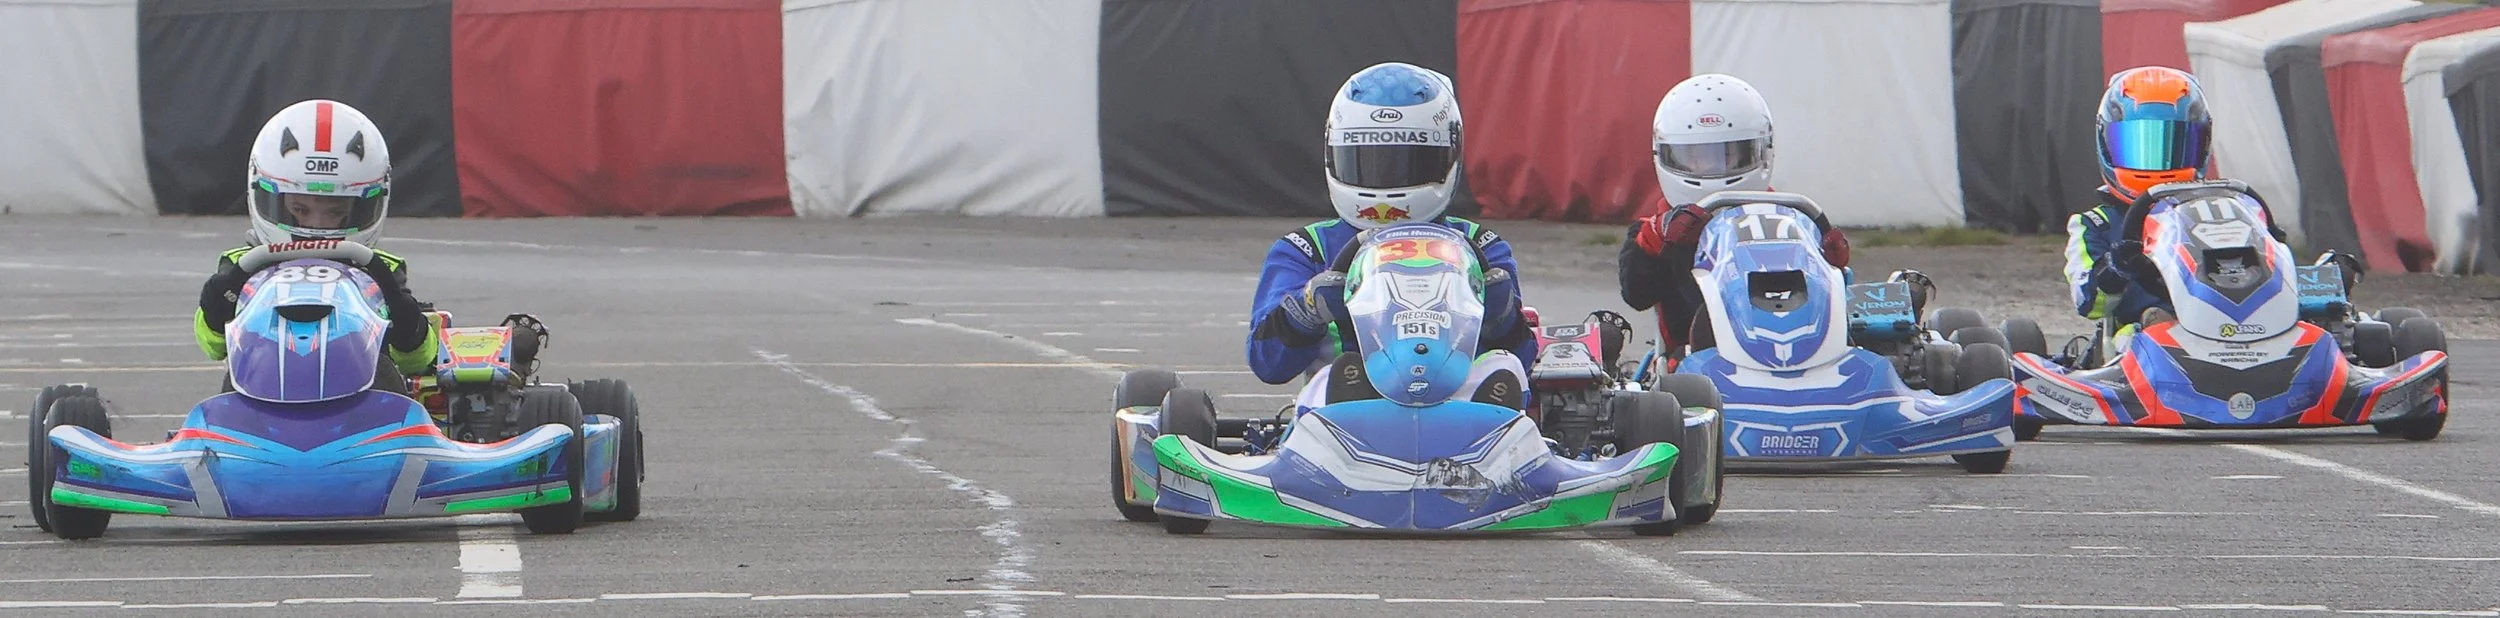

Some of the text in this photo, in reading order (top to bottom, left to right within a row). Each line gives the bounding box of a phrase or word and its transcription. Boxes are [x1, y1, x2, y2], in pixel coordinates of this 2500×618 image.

[1376, 108, 1400, 120] Arai
[1700, 116, 1722, 124] BELL
[1343, 131, 1429, 143] PETRONAS
[305, 160, 339, 172] OMP
[2190, 199, 2237, 221] 11
[1738, 213, 1799, 240] 17
[267, 239, 345, 253] WRIGHT
[274, 264, 342, 283] 89
[1395, 311, 1446, 323] PRECISION
[1761, 435, 1820, 449] BRIDGER
